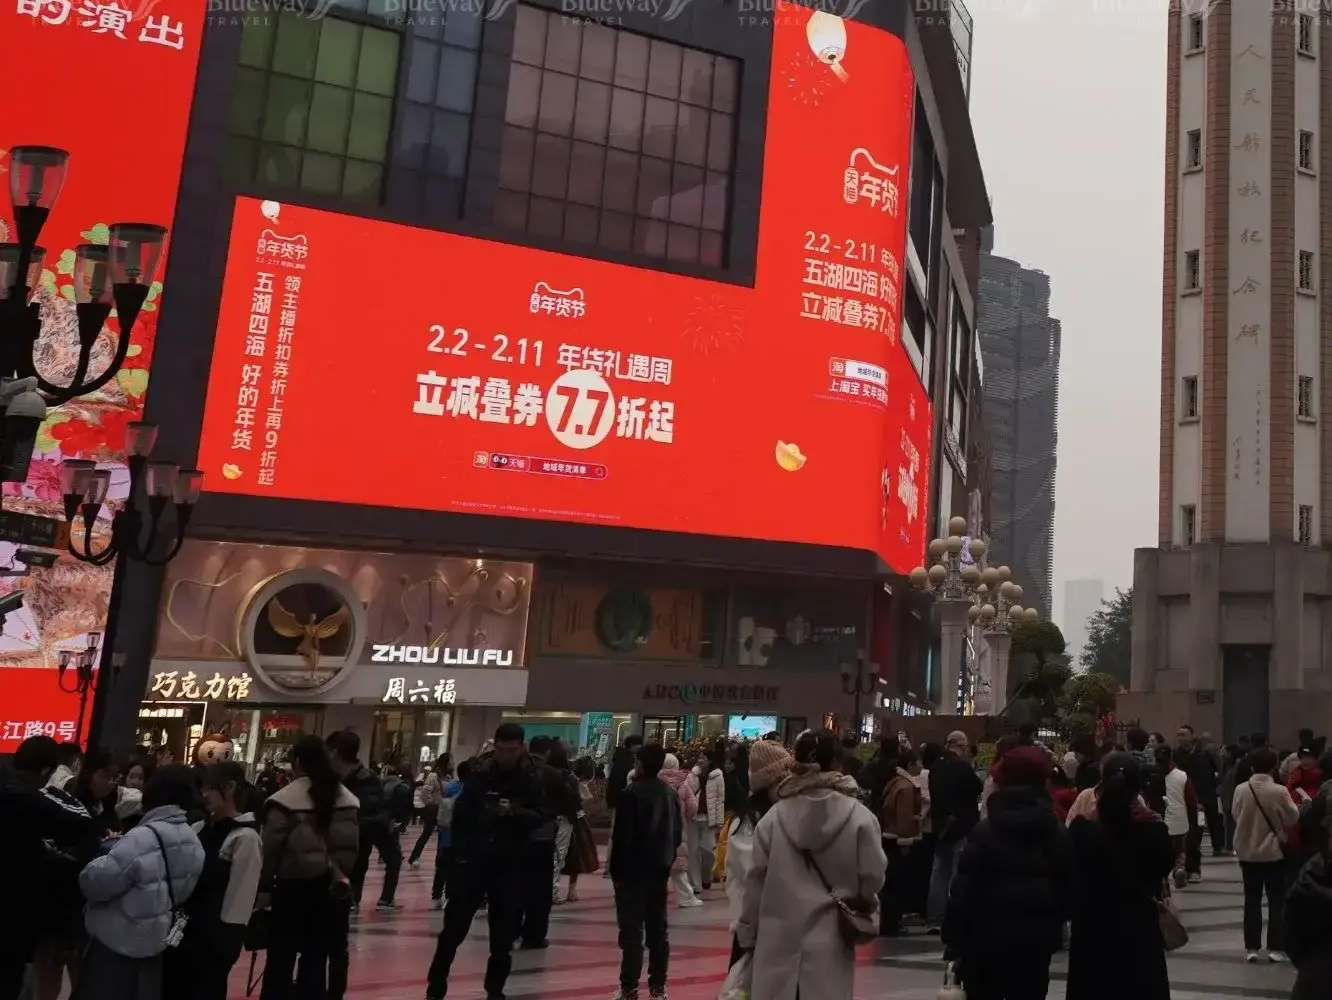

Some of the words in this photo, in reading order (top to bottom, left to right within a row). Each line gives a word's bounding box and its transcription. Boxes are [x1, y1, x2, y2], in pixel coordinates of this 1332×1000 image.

[802, 258, 878, 297] 五湖四海
[245, 271, 276, 357] 五湖四海
[540, 295, 586, 318] 年货节
[557, 343, 672, 386] 年货礼遇周
[231, 363, 262, 451] 好的年货
[371, 644, 440, 664] ZHOU
[443, 647, 479, 665] LIU
[482, 649, 513, 666] FU
[151, 670, 253, 700] 巧克力馆
[382, 677, 457, 704] 周六福
[0, 720, 77, 741] 江路9号
